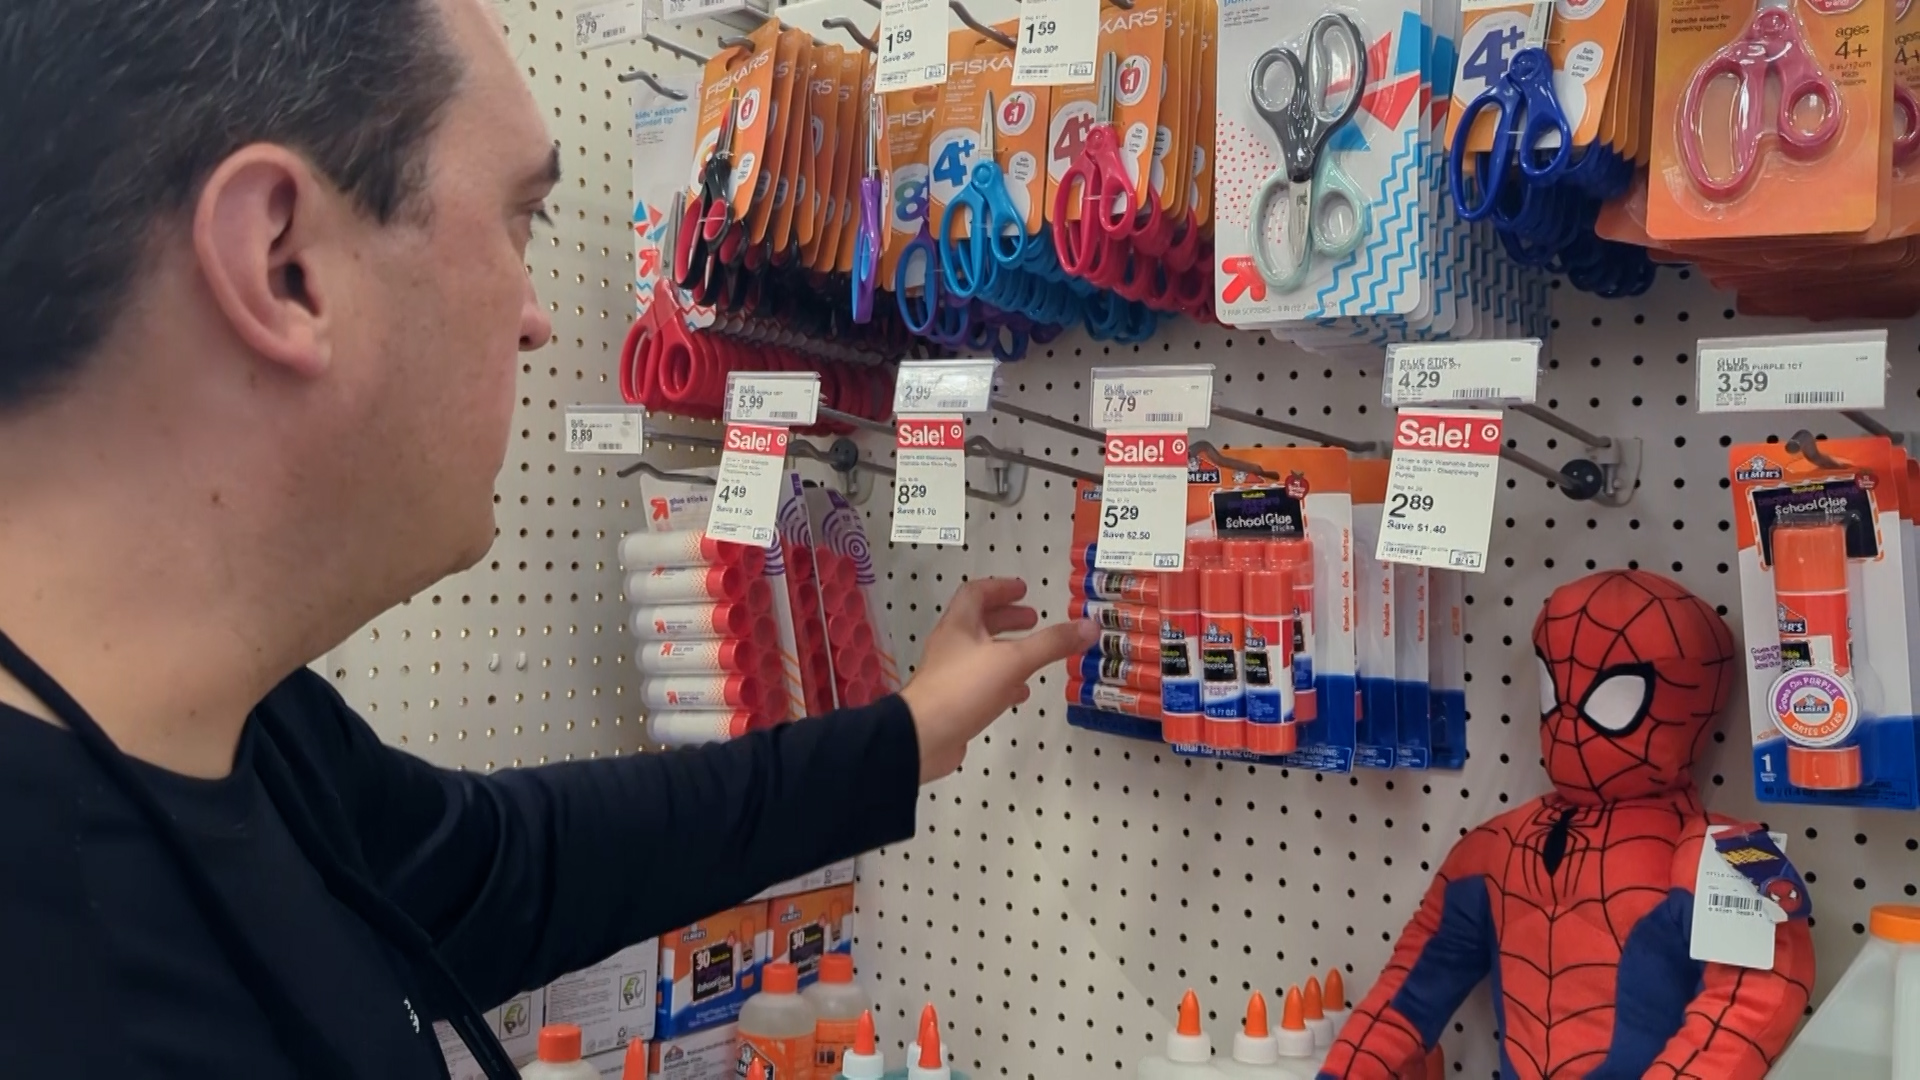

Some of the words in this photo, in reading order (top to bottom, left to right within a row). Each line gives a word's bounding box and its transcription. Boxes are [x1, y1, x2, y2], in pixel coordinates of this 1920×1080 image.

[1100, 9, 1158, 34] KARS
[1835, 25, 1869, 40] ages
[1463, 25, 1524, 88] 4+
[1835, 41, 1867, 59] 4+
[705, 48, 772, 99] FISKARS
[948, 56, 1012, 76] FISKA
[887, 107, 936, 128] FISK
[933, 139, 975, 188] 4+
[1398, 370, 1441, 388] 4.29
[1718, 371, 1768, 392] 3.59
[738, 395, 763, 409] 5.99
[905, 385, 931, 401] 2.99
[1104, 396, 1137, 412] 7.79
[571, 428, 593, 441] 8.89
[727, 428, 772, 452] Sale!
[898, 423, 945, 446] Sale!
[1397, 419, 1472, 449] Sale!
[1107, 439, 1164, 462] Sale!
[1188, 472, 1218, 482] MER'S
[1739, 470, 1780, 480] ELMER'S
[1775, 500, 1817, 515] School
[1818, 497, 1848, 508] Glue
[1225, 514, 1265, 529] School
[1265, 513, 1292, 526] Glue
[1386, 519, 1414, 531] Save
[1417, 523, 1447, 534] $1.40
[1102, 529, 1125, 538] Save
[1127, 531, 1150, 540] $2.50
[1761, 753, 1772, 772] 1
[695, 951, 711, 970] 30
